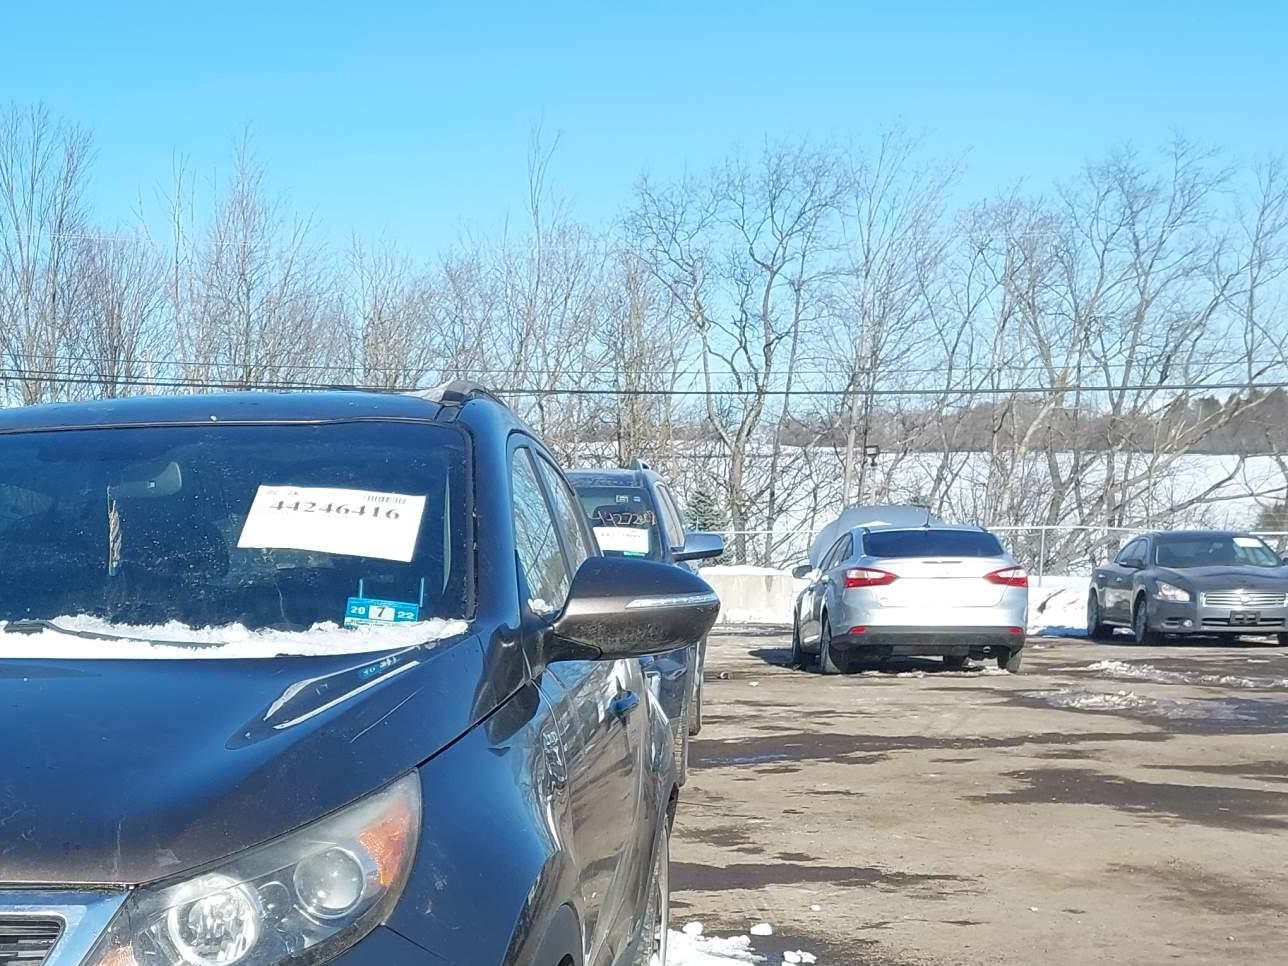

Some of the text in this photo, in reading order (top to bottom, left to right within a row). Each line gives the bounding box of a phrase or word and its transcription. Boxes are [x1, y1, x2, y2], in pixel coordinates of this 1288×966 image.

[269, 500, 400, 520] 44246416
[350, 606, 415, 620] 20 7 22
